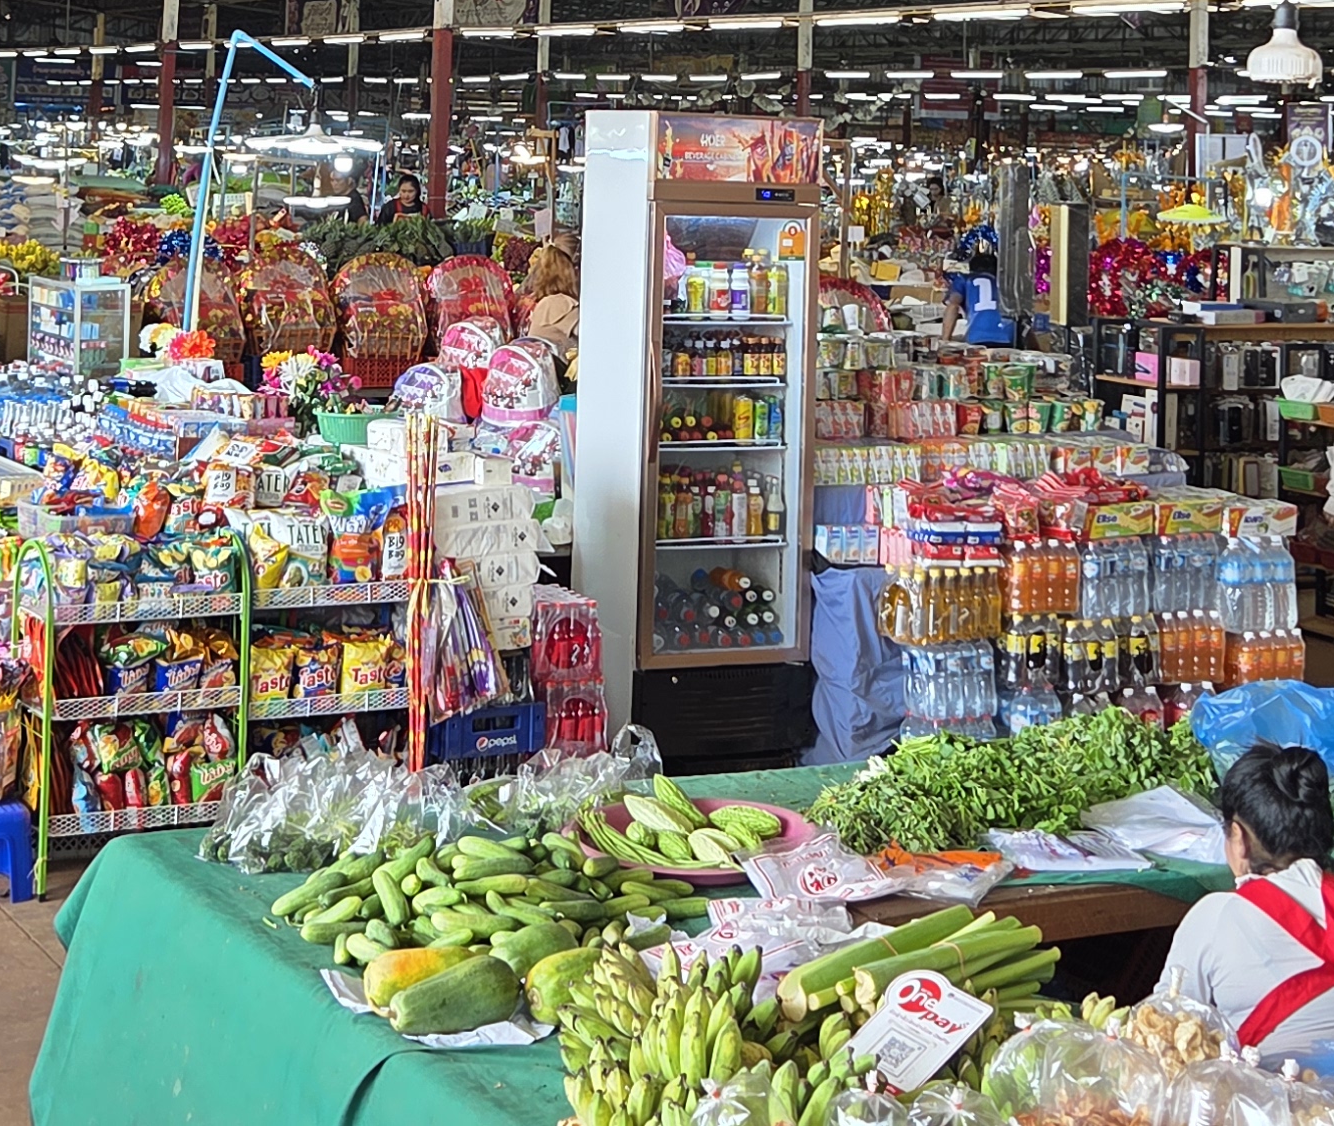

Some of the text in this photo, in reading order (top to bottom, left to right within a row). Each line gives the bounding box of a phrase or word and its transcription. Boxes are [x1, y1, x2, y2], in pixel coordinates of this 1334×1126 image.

[972, 277, 998, 312] 1
[487, 734, 518, 751] pepsi
[897, 978, 940, 1011] One
[918, 1009, 963, 1035] pay
